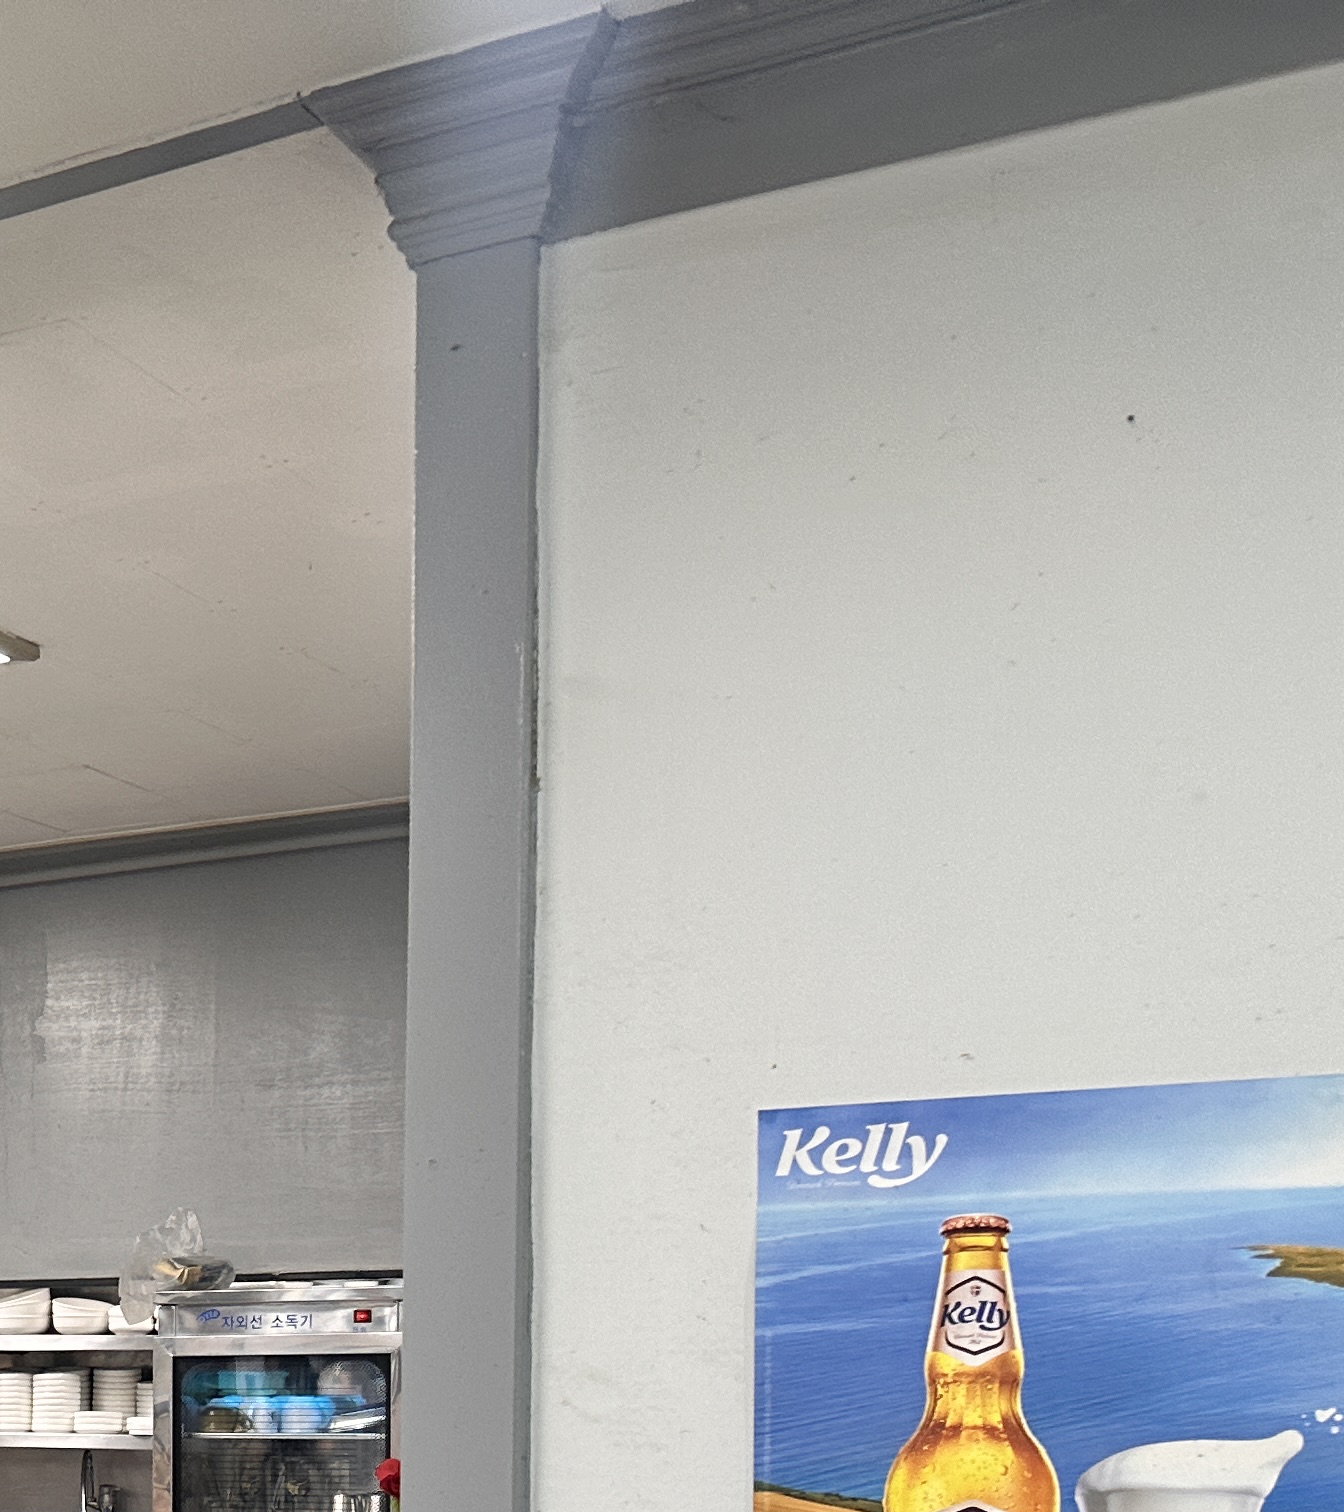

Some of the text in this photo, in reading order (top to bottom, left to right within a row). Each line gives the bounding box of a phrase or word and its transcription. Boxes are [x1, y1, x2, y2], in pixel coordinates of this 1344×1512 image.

[775, 1121, 949, 1188] Kelly
[221, 1314, 263, 1330] 자외선
[270, 1313, 314, 1329] 소독기
[941, 1300, 1010, 1332] Kelly
